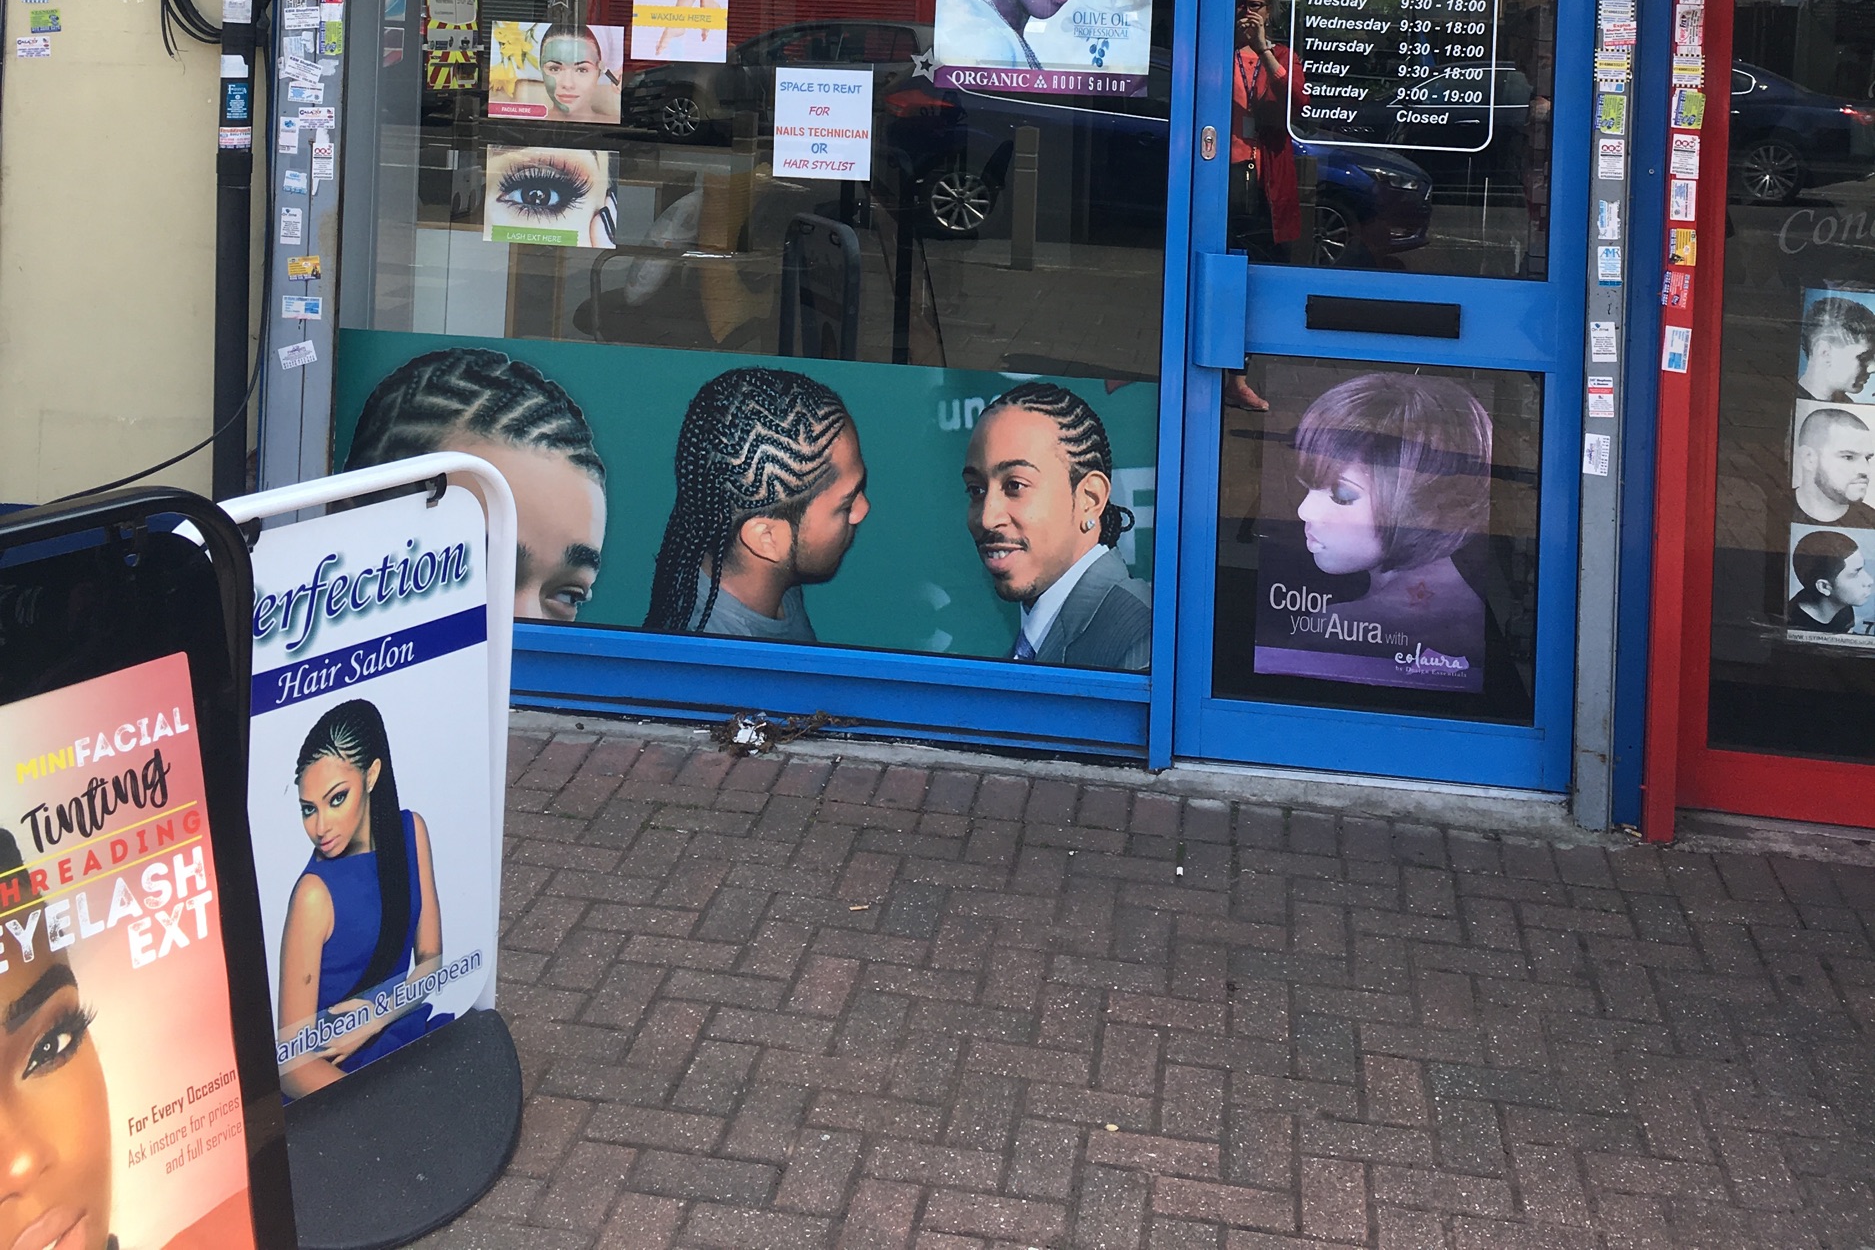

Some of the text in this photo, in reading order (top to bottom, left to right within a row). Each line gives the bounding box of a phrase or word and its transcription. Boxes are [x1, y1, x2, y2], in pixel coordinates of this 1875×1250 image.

[1446, 0, 1487, 13] 18:00
[650, 12, 712, 23] WAXING HERE
[1072, 11, 1131, 27] OLIVE OIL
[1305, 15, 1391, 34] Wednesday
[1399, 20, 1431, 33] 9:30
[1445, 22, 1485, 35] 18:00
[1073, 28, 1129, 38] PROFESSIONAL
[1304, 38, 1374, 56] Thursday
[1398, 43, 1430, 56] 9:30
[1444, 45, 1484, 58] 18:00
[951, 69, 1030, 88] ORGANIC
[1052, 75, 1082, 90] ROOT
[1303, 61, 1350, 78] Friday
[1398, 65, 1430, 78] 9:30
[1443, 68, 1483, 81] 18:00
[780, 82, 862, 94] SPACE TO RENT
[1302, 83, 1368, 101] Saturday
[1397, 87, 1429, 101] 9:00
[1442, 90, 1483, 103] 19:00
[808, 106, 830, 117] FOR
[1301, 106, 1449, 125] Sunday Closed
[776, 126, 869, 139] NAILS TECHNICIAN
[811, 143, 828, 154] OR
[783, 159, 855, 171] HAIR STYLIST
[506, 232, 562, 243] LASH EXT HERE
[1778, 209, 1875, 255] Con
[253, 538, 468, 651] erfection
[1269, 582, 1332, 614] Color
[1290, 613, 1409, 646] your Aura with
[1394, 642, 1464, 669] colaura
[276, 637, 415, 704] Hair Salon
[20, 748, 172, 854] Tinting
[127, 890, 213, 970] EXT
[275, 949, 483, 1065] aribbean & European
[128, 1069, 237, 1137] For Every Occasion
[128, 1096, 240, 1168] Ask instore for prices
[166, 1121, 243, 1175] and full service
